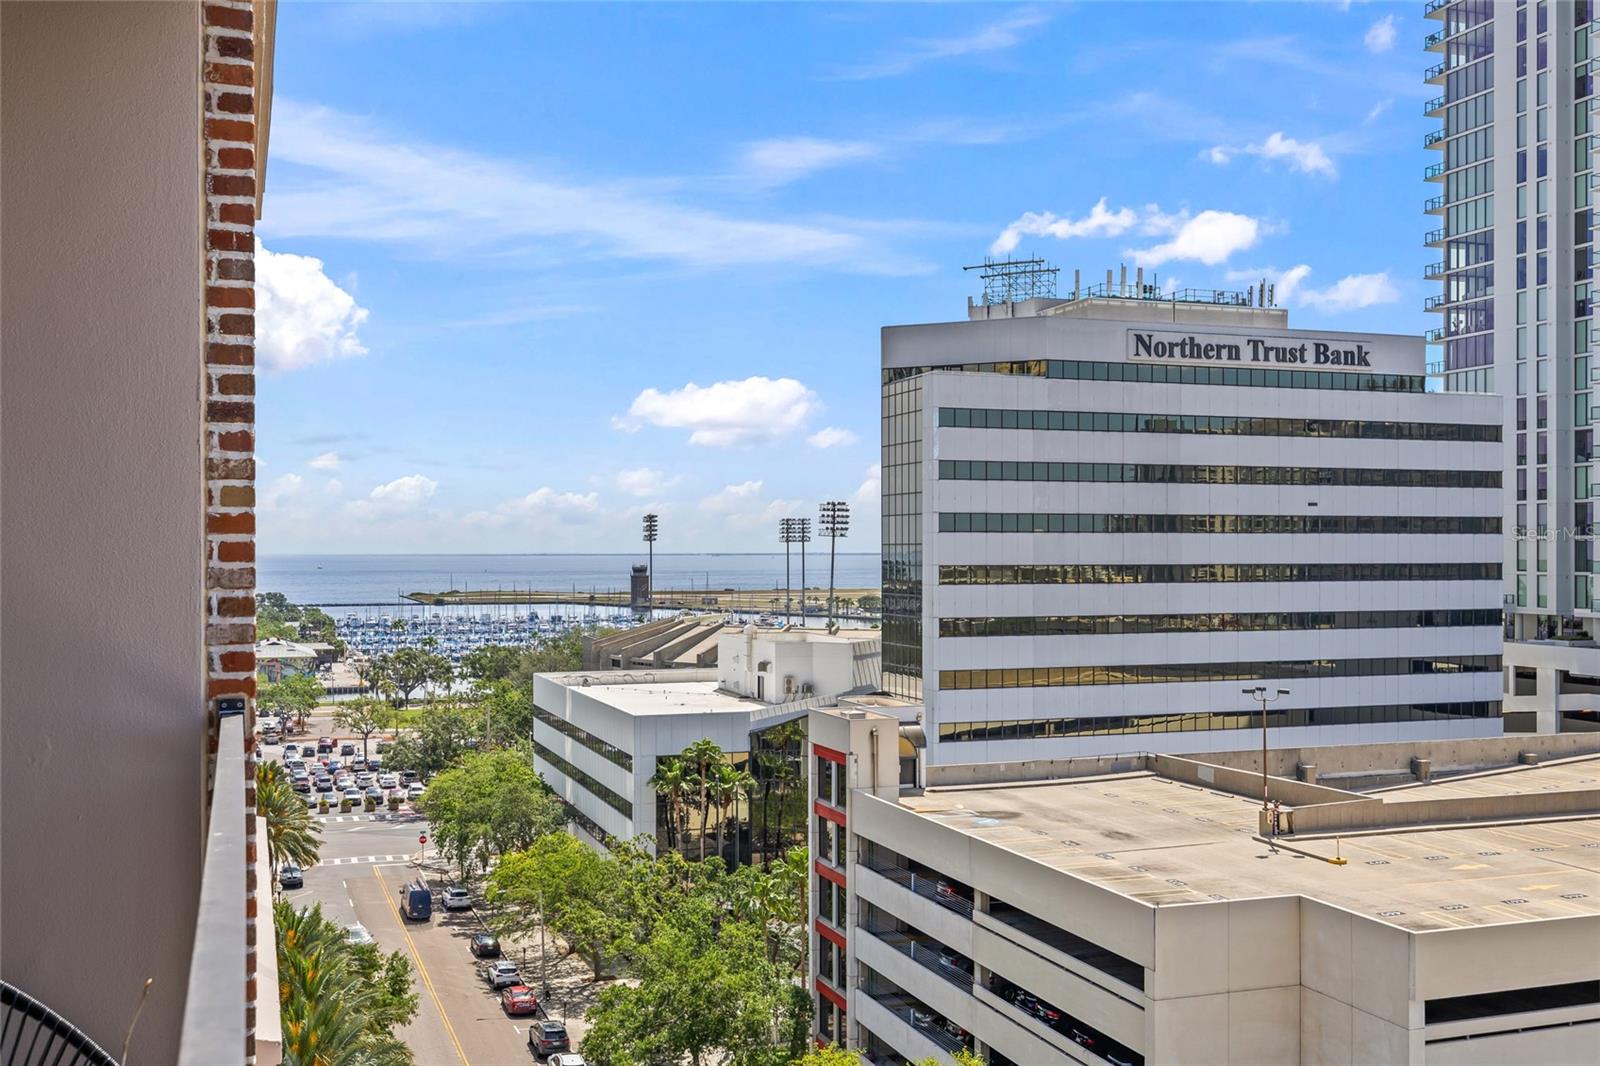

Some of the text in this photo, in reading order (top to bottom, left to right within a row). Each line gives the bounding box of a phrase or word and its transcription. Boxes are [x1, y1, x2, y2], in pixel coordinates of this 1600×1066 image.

[1133, 333, 1371, 367] Northern Trust Bank
